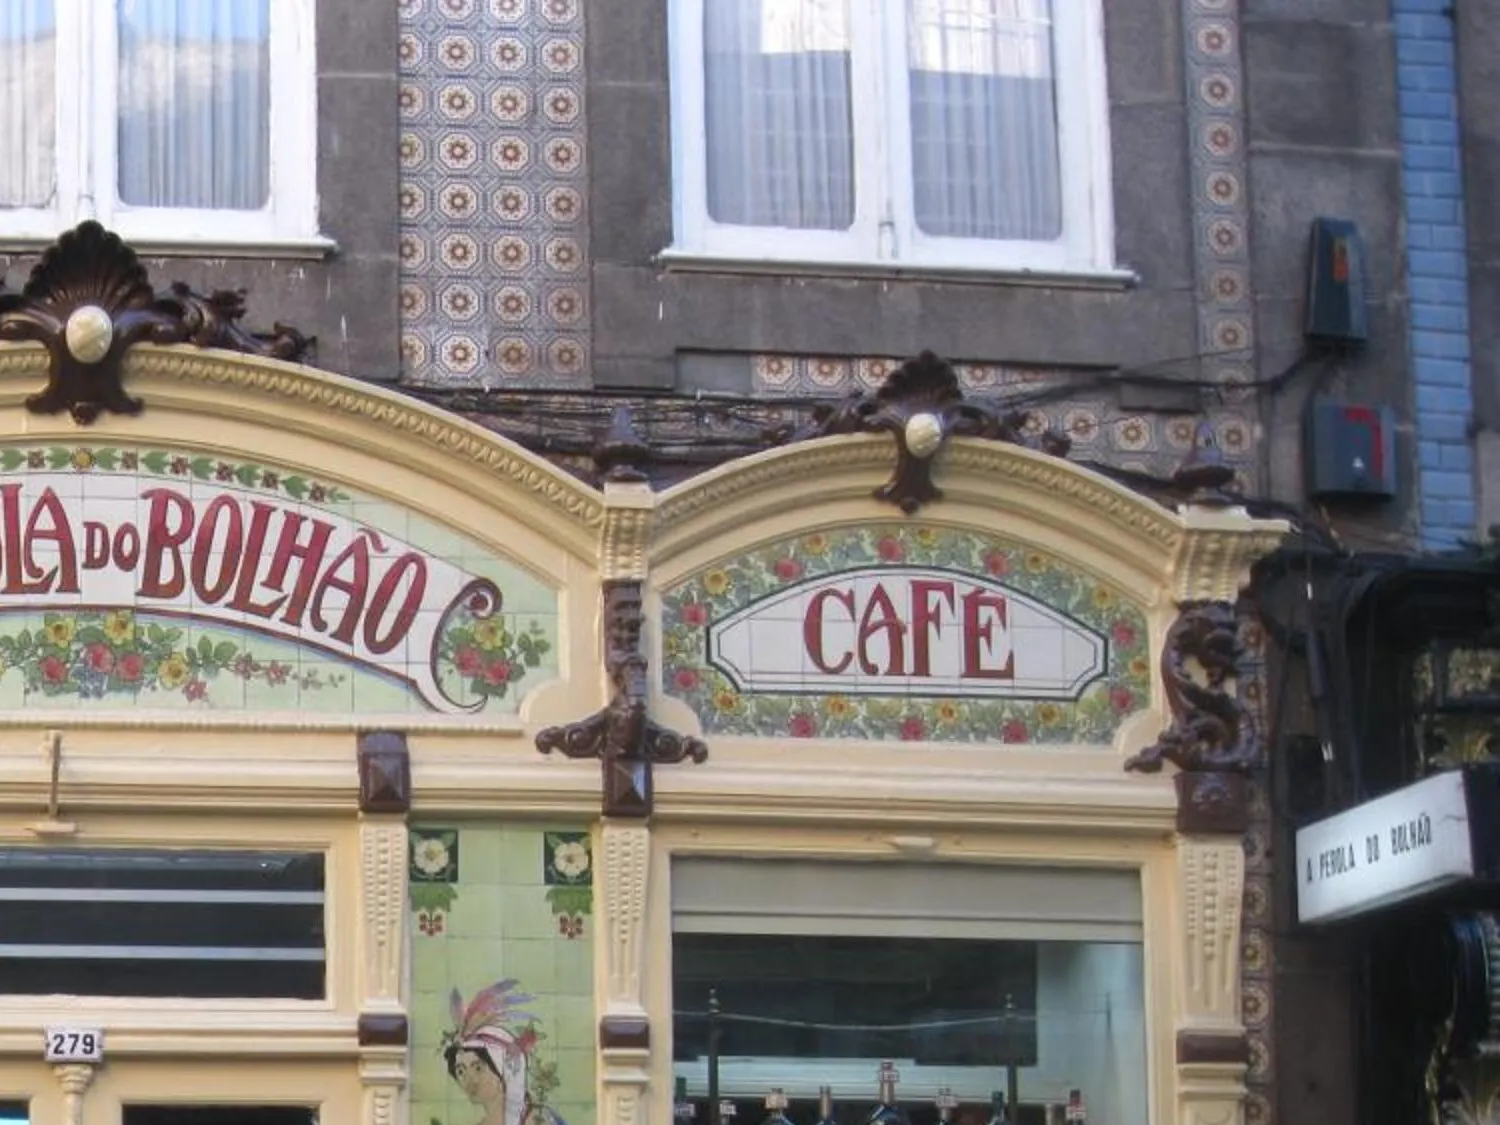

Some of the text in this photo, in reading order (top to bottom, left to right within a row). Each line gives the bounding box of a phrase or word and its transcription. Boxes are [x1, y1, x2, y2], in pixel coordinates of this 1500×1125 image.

[81, 520, 140, 571] DO
[136, 486, 428, 656] BOLHÃO
[802, 579, 1016, 680] CAFÉ
[1306, 857, 1314, 883] A
[52, 1032, 96, 1056] 279
